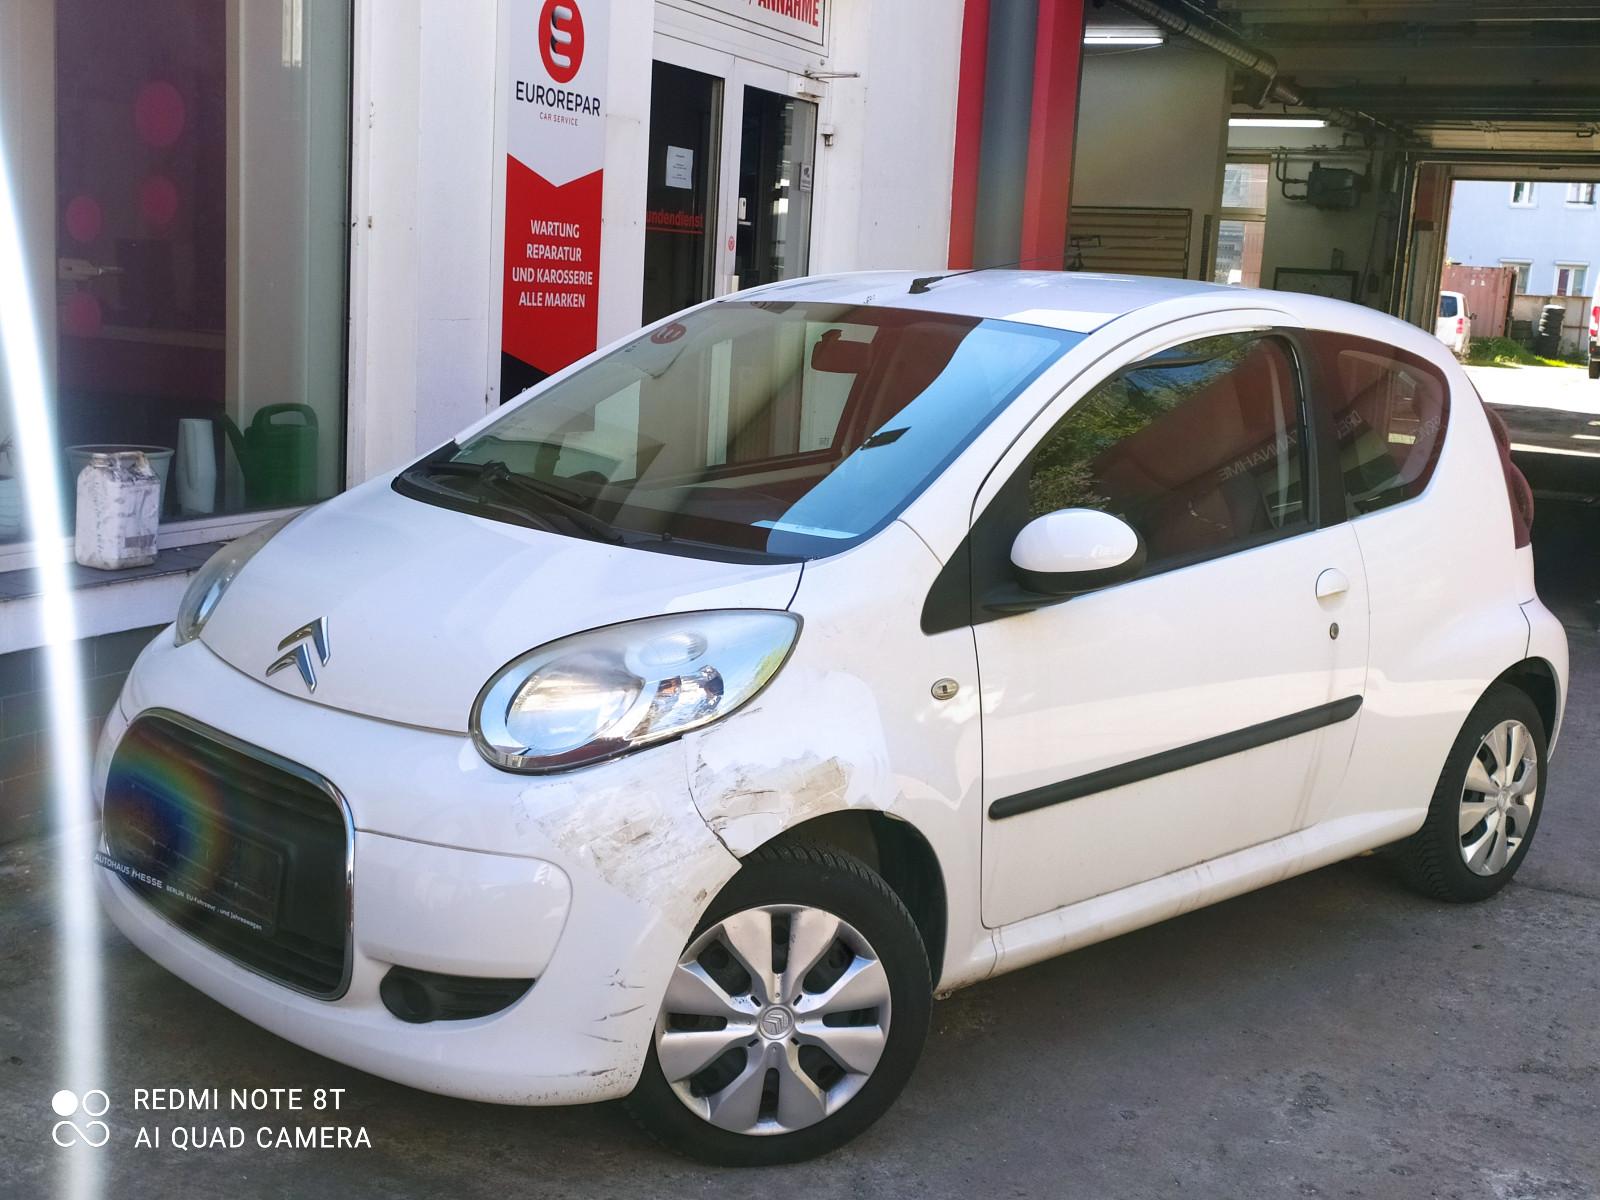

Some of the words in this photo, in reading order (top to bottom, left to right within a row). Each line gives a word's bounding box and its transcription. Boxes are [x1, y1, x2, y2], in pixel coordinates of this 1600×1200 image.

[757, 0, 820, 28] NAHME
[516, 80, 601, 117] EUROREPAR
[539, 112, 552, 121] CAR
[554, 114, 579, 127] SERVICE
[646, 208, 704, 227] undendienst
[530, 219, 580, 239] WARTUNG
[526, 243, 582, 262] REPARATUR
[512, 267, 535, 283] UND
[536, 268, 594, 286] KAROSSERIE
[518, 291, 543, 306] ALLE
[544, 292, 586, 308] MARKEN
[94, 853, 131, 875] AUTOHAUS
[166, 884, 185, 897] BERLIN
